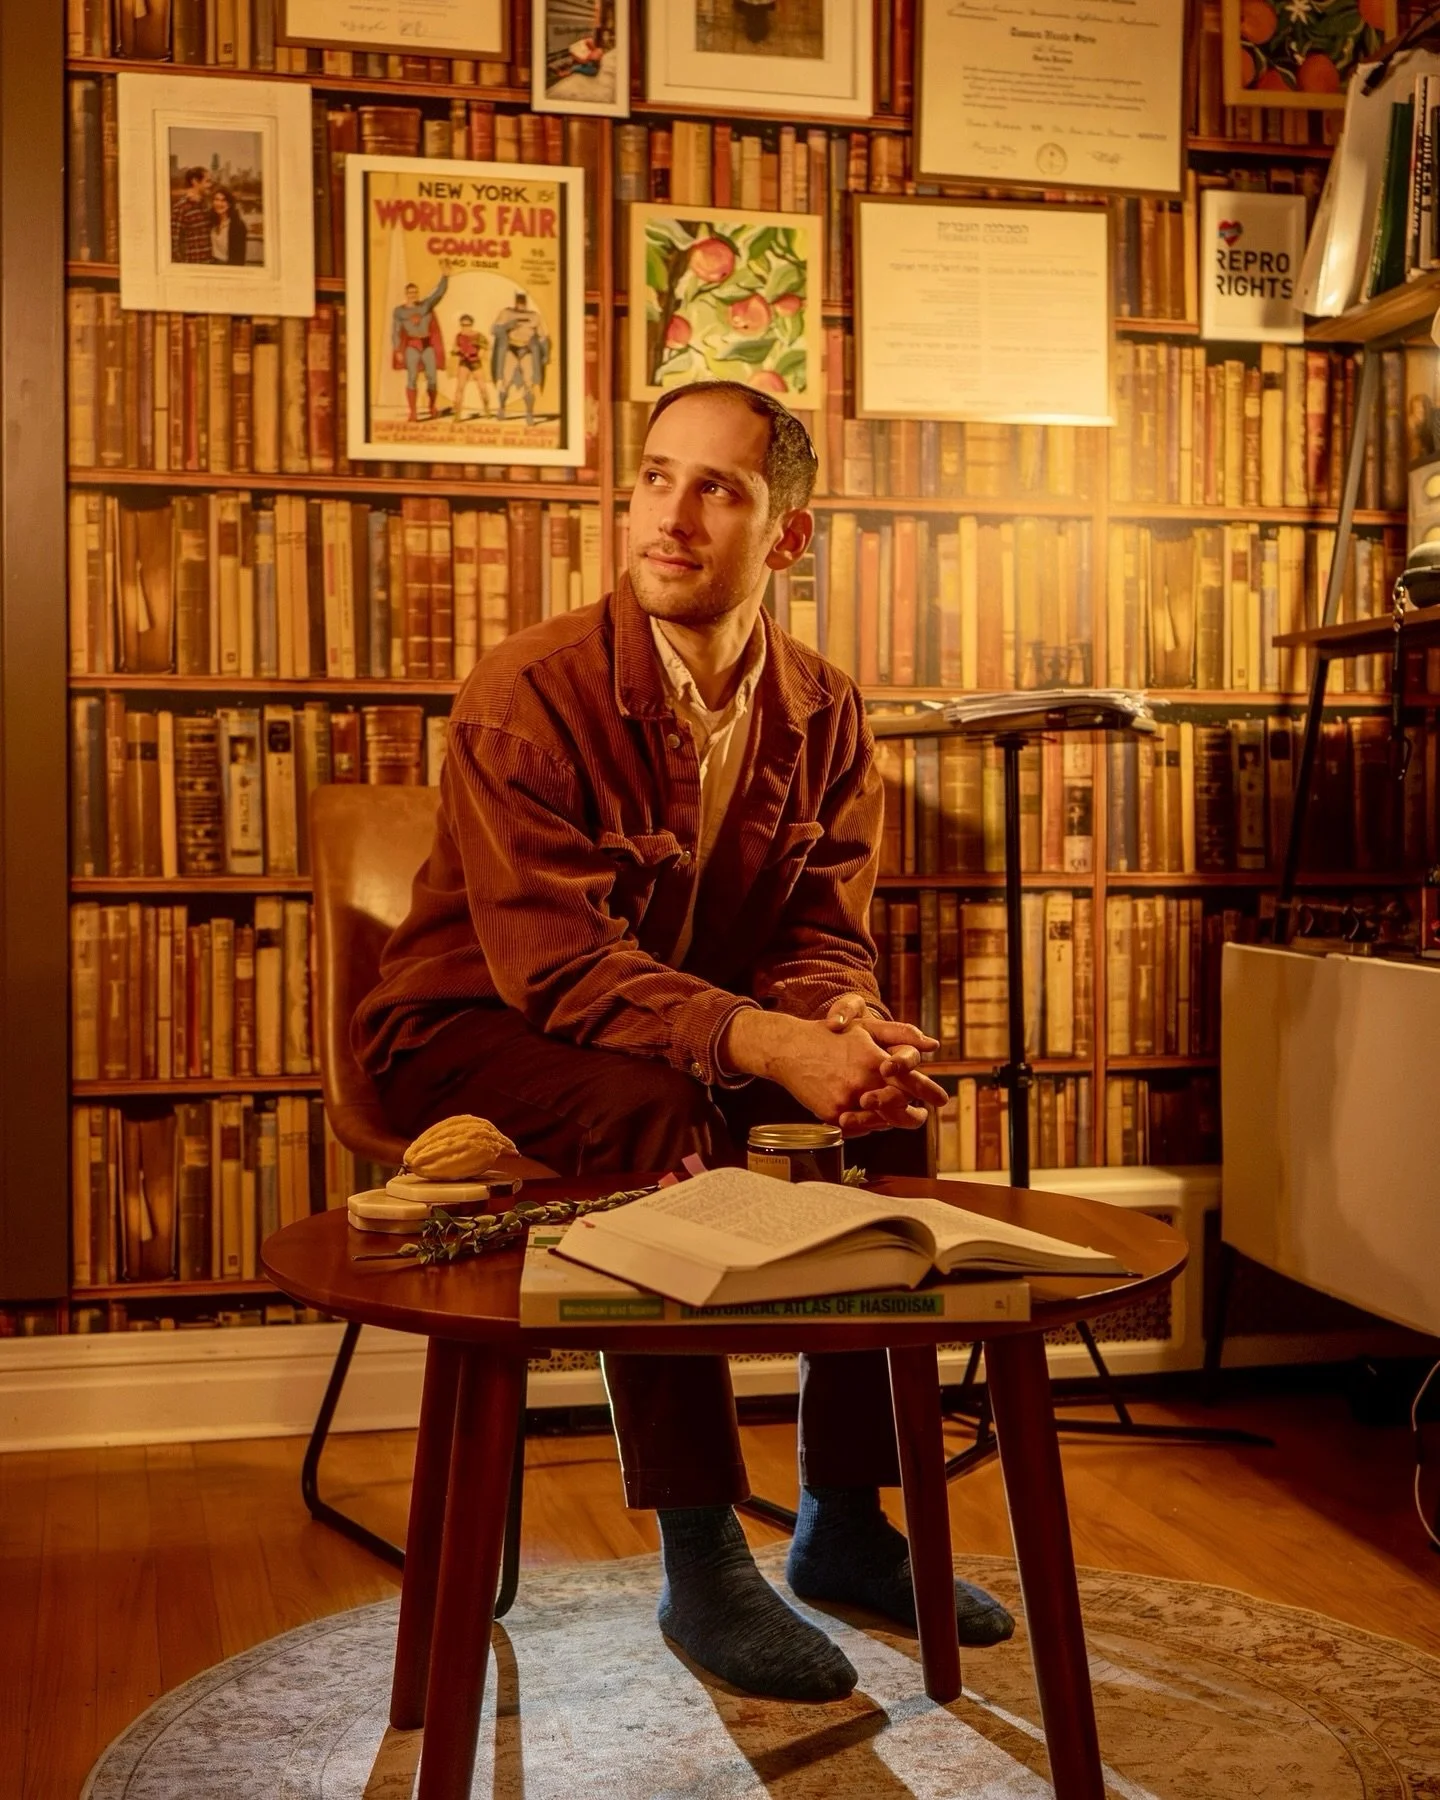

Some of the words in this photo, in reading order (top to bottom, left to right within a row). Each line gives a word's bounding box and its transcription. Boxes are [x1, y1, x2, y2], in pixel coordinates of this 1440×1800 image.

[418, 181, 464, 200] NEW
[471, 184, 532, 203] YORK
[374, 198, 487, 235] WORLD'S
[496, 205, 558, 239] FAIR
[426, 237, 513, 259] COMICS
[470, 260, 500, 270] ISSUE
[1216, 249, 1291, 273] REPRO
[1216, 275, 1294, 300] RIGHTS
[783, 1300, 832, 1315] ATLAS
[836, 1299, 856, 1314] OF
[859, 1297, 937, 1314] HASIDISM
